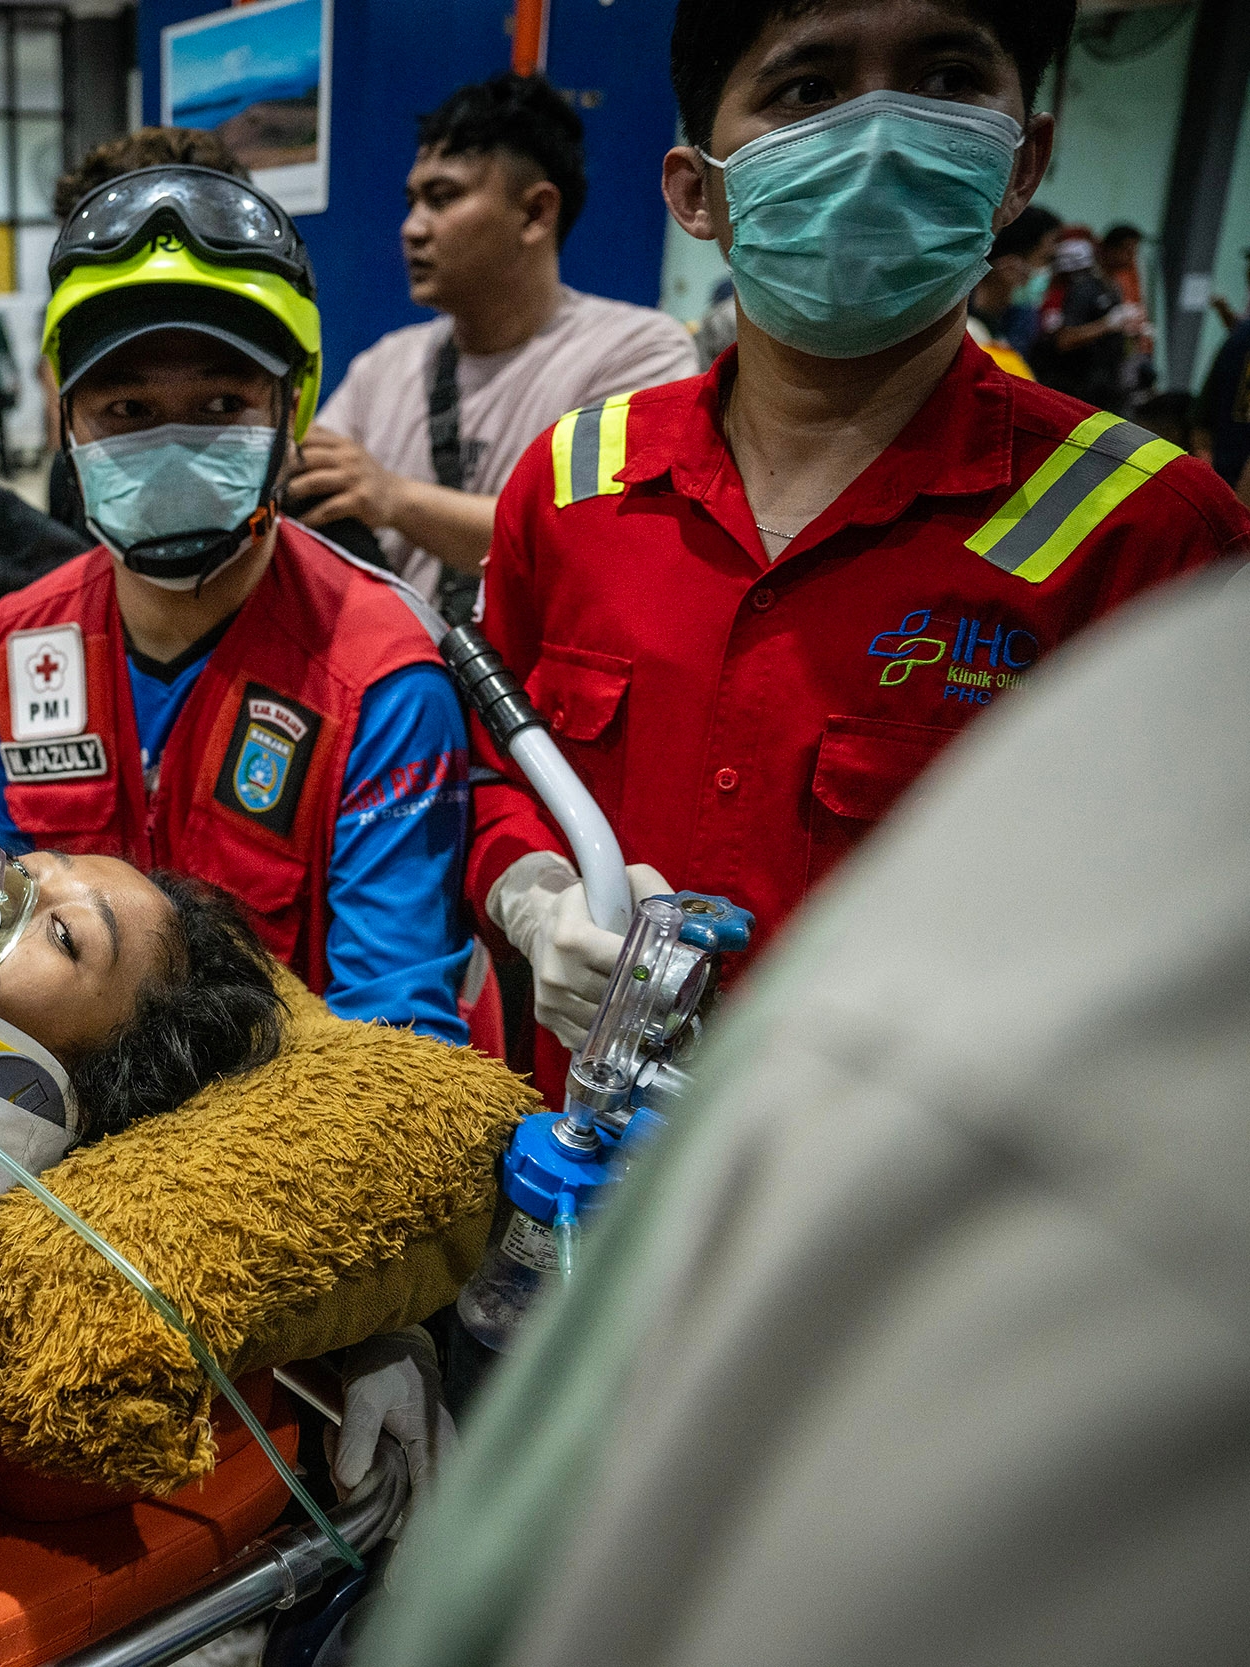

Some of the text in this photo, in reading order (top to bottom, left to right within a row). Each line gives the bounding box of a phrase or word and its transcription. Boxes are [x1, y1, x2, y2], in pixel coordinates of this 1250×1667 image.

[952, 617, 1039, 669] IHC
[947, 665, 992, 688] Klinik
[943, 685, 992, 705] PHC
[29, 698, 70, 722] PMI
[531, 1224, 551, 1238] IHC
